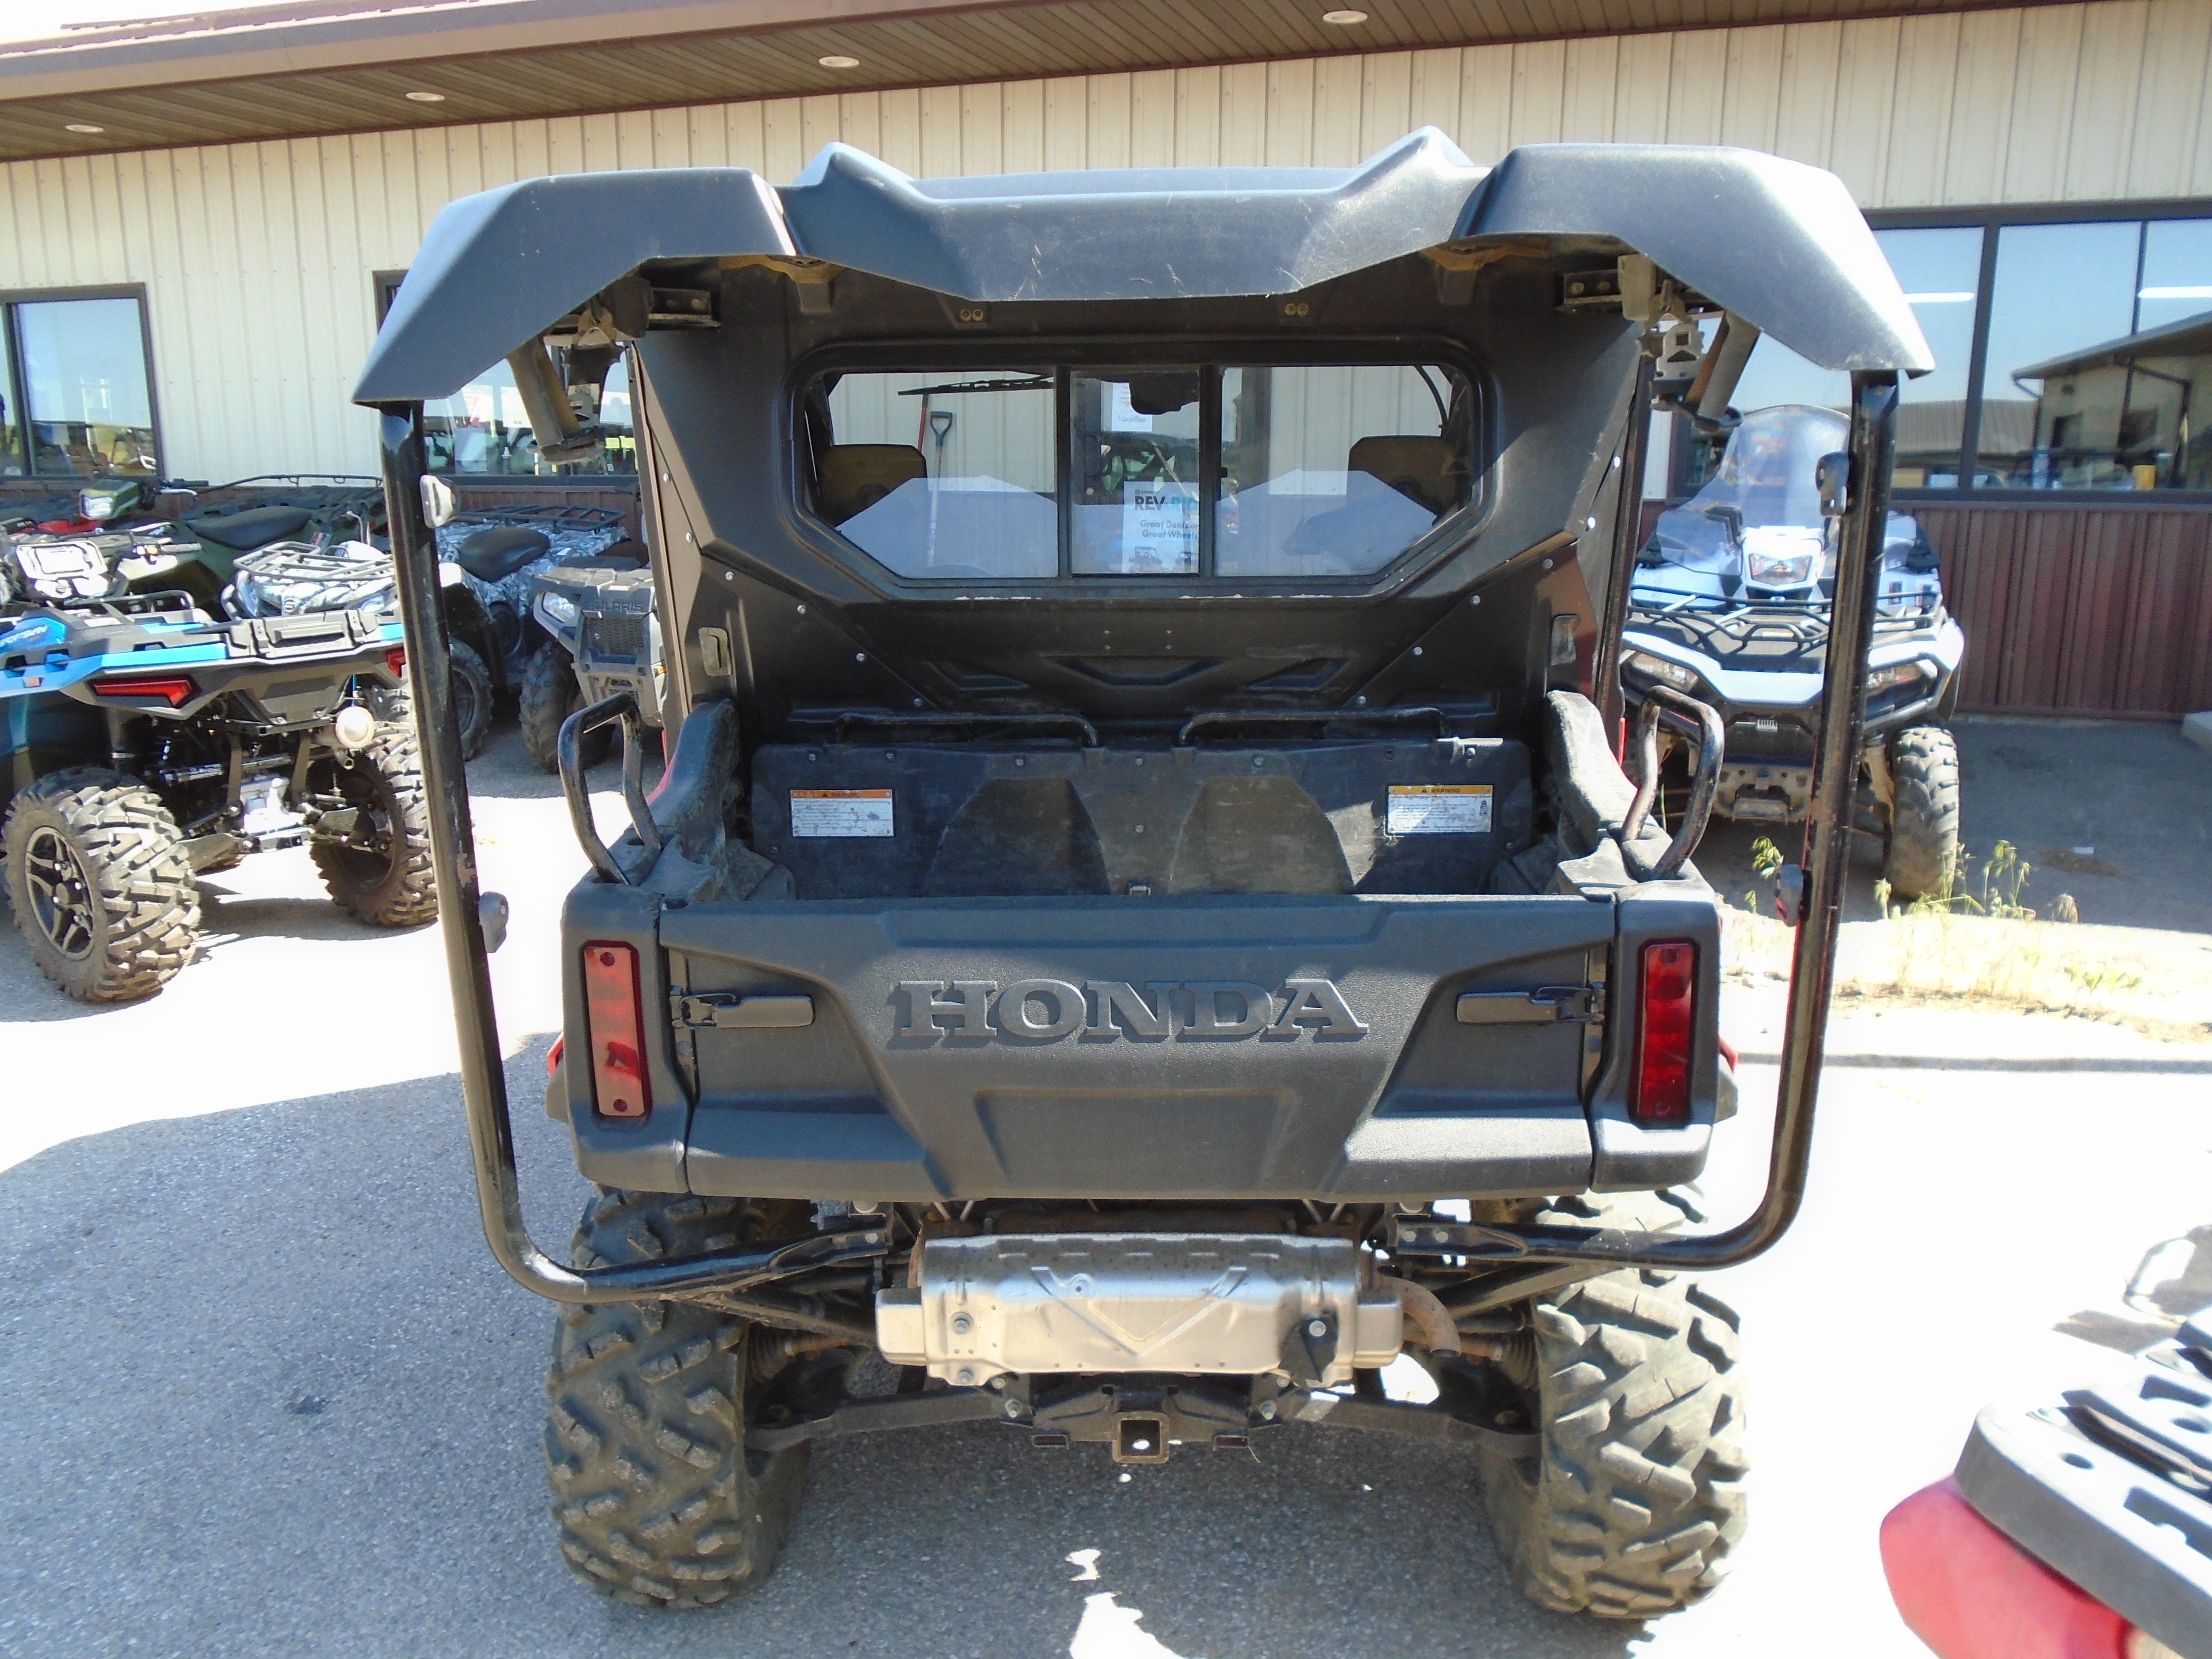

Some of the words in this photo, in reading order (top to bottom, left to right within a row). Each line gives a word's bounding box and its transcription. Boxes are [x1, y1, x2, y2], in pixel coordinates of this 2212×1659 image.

[1135, 496, 1166, 510] REV
[1140, 520, 1164, 528] Great
[1166, 520, 1188, 529] Deals
[1142, 529, 1166, 538] Great
[1168, 530, 1199, 539] Wheels
[899, 978, 1369, 1037] HONDA
